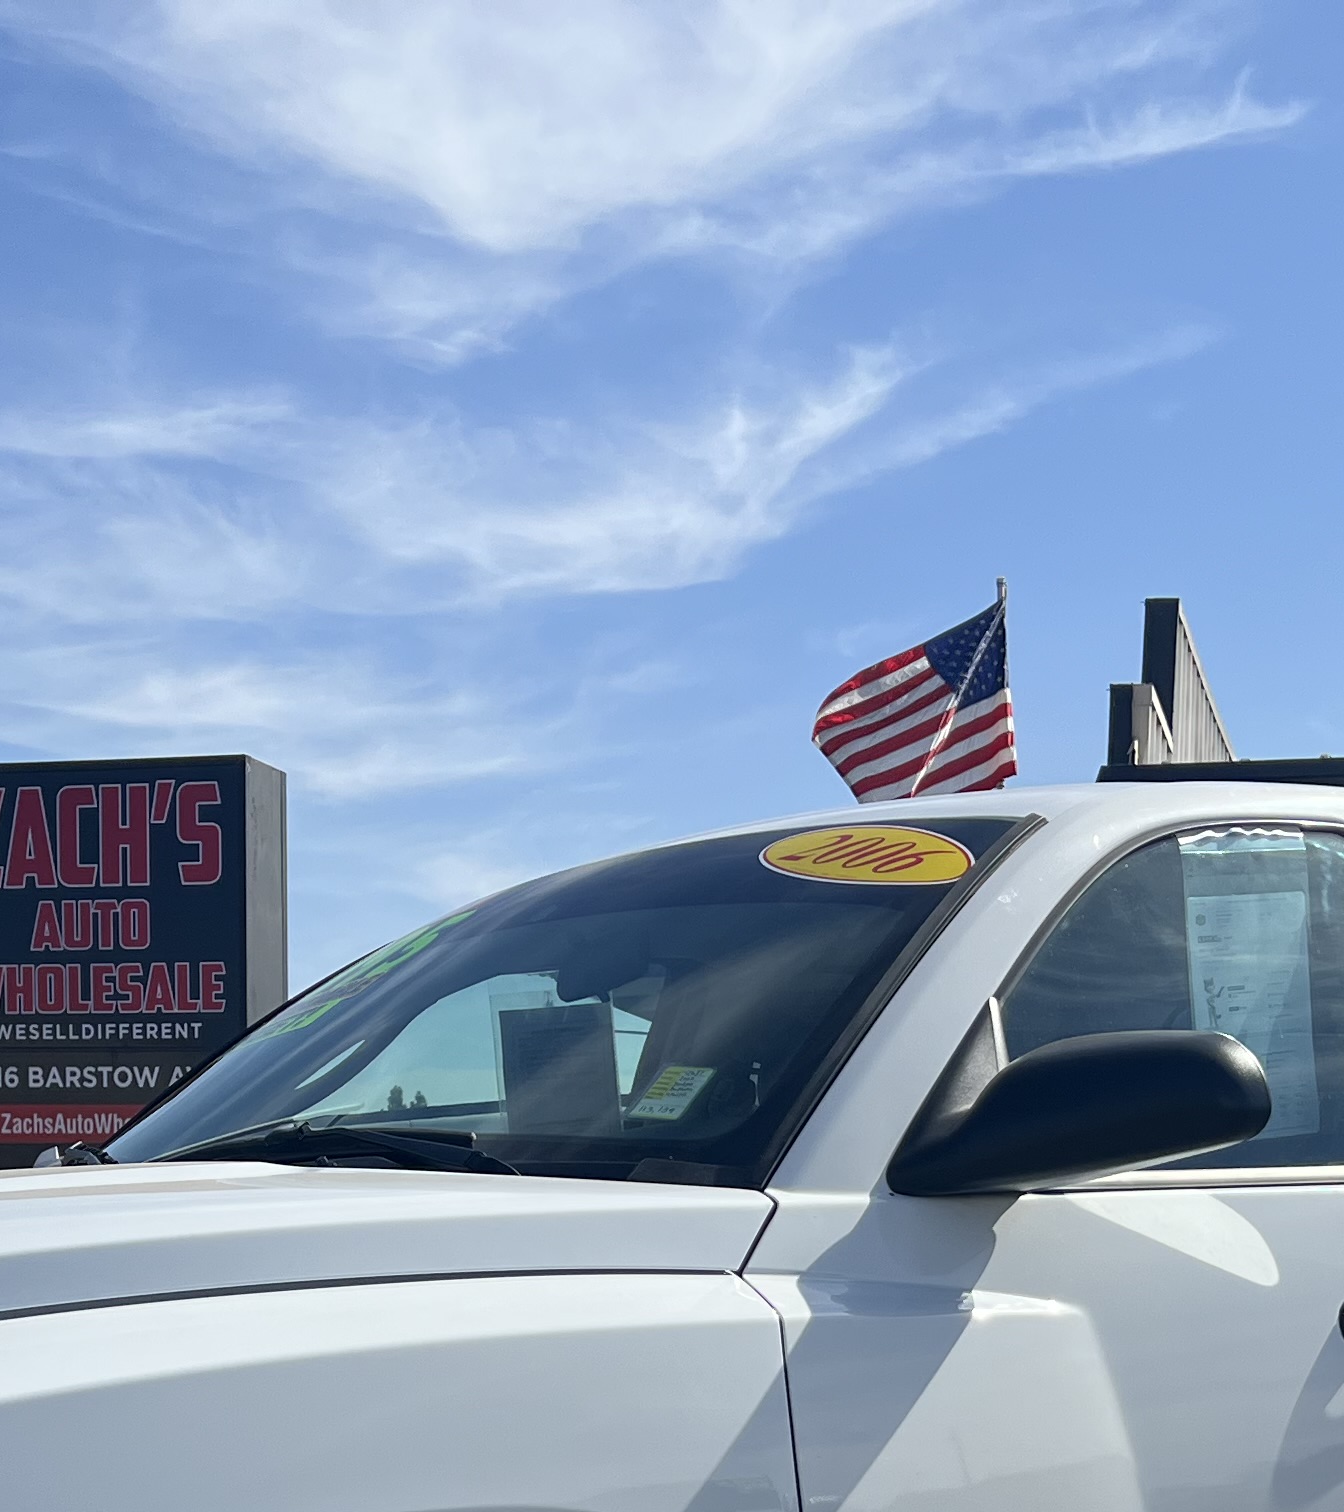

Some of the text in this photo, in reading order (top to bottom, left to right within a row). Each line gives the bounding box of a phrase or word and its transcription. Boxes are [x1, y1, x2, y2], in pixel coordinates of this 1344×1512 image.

[776, 834, 957, 874] 2006
[30, 899, 150, 951] AUTO
[28, 1066, 159, 1089] BARSTOW
[168, 1066, 192, 1087] A
